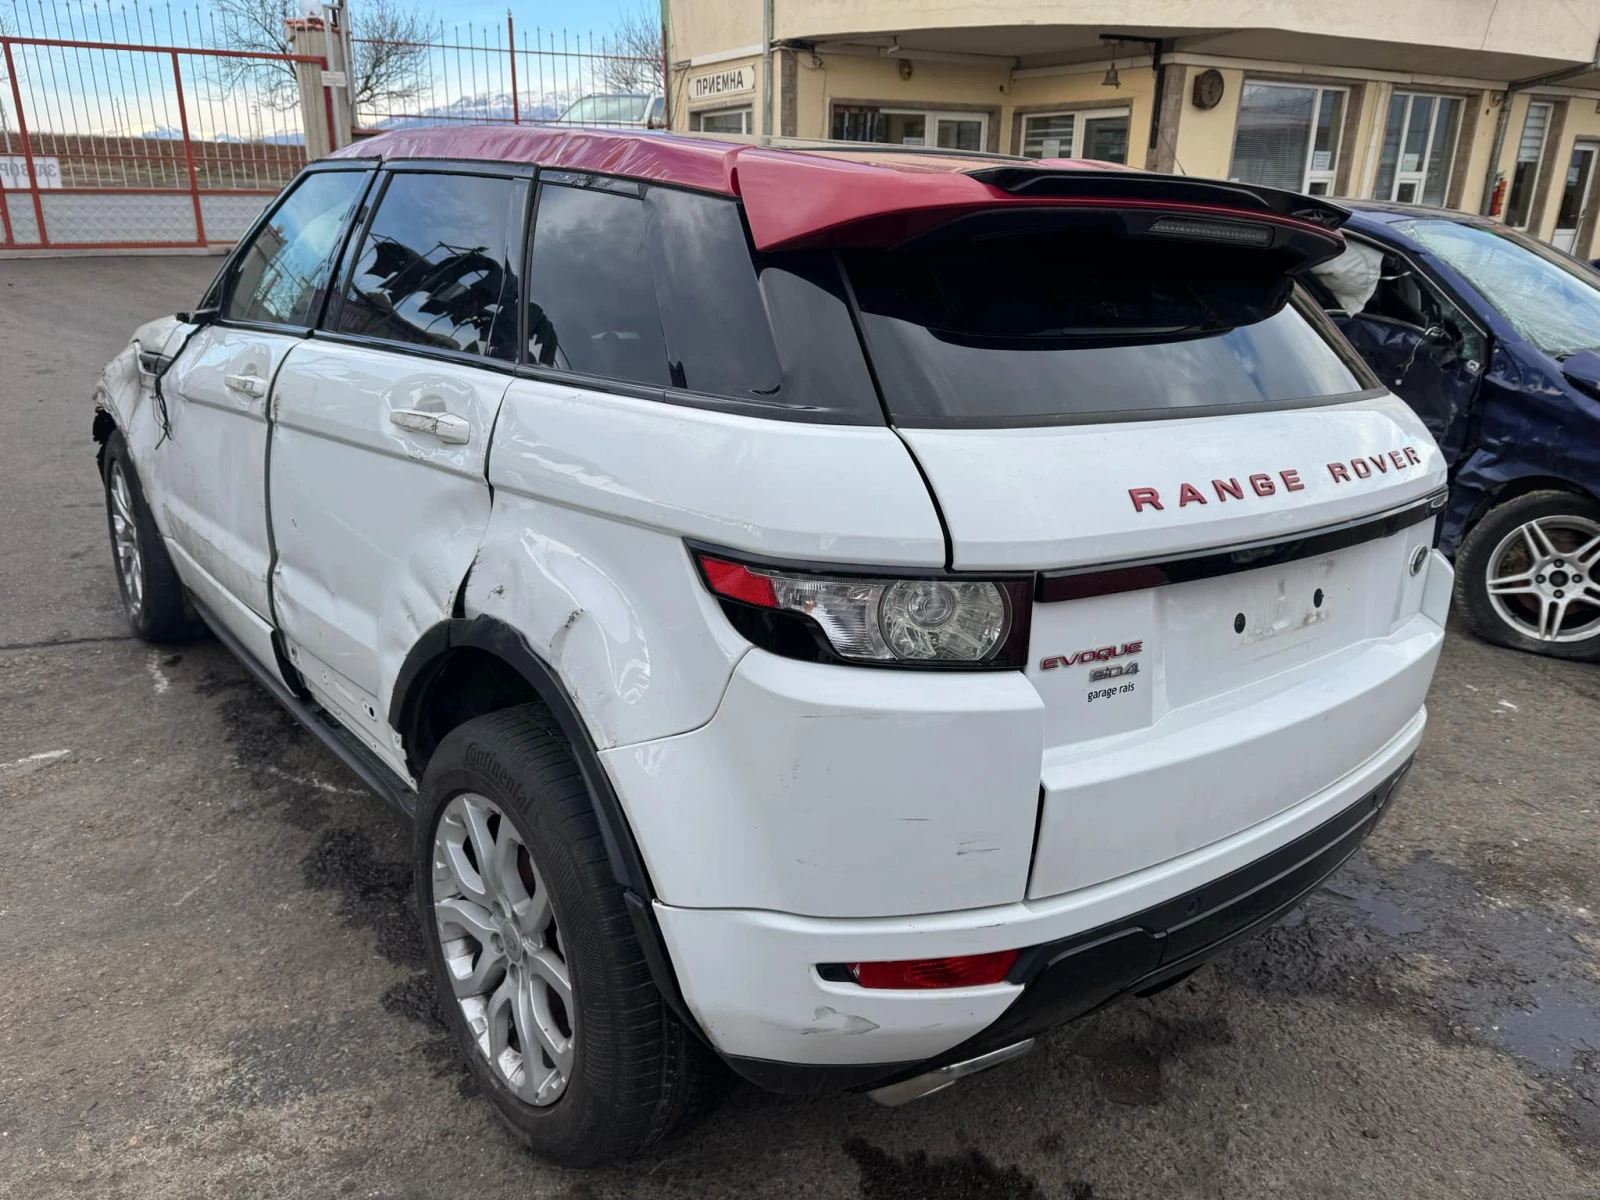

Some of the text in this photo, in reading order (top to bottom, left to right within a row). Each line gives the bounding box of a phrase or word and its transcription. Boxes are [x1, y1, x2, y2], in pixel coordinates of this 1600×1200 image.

[695, 70, 744, 96] ПРИЕМНА
[1128, 446, 1421, 513] RANGE ROVER
[1040, 640, 1143, 671] EVOQUE
[1089, 661, 1140, 682] SD4
[1087, 682, 1135, 703] garage rais
[465, 741, 536, 814] Continental
